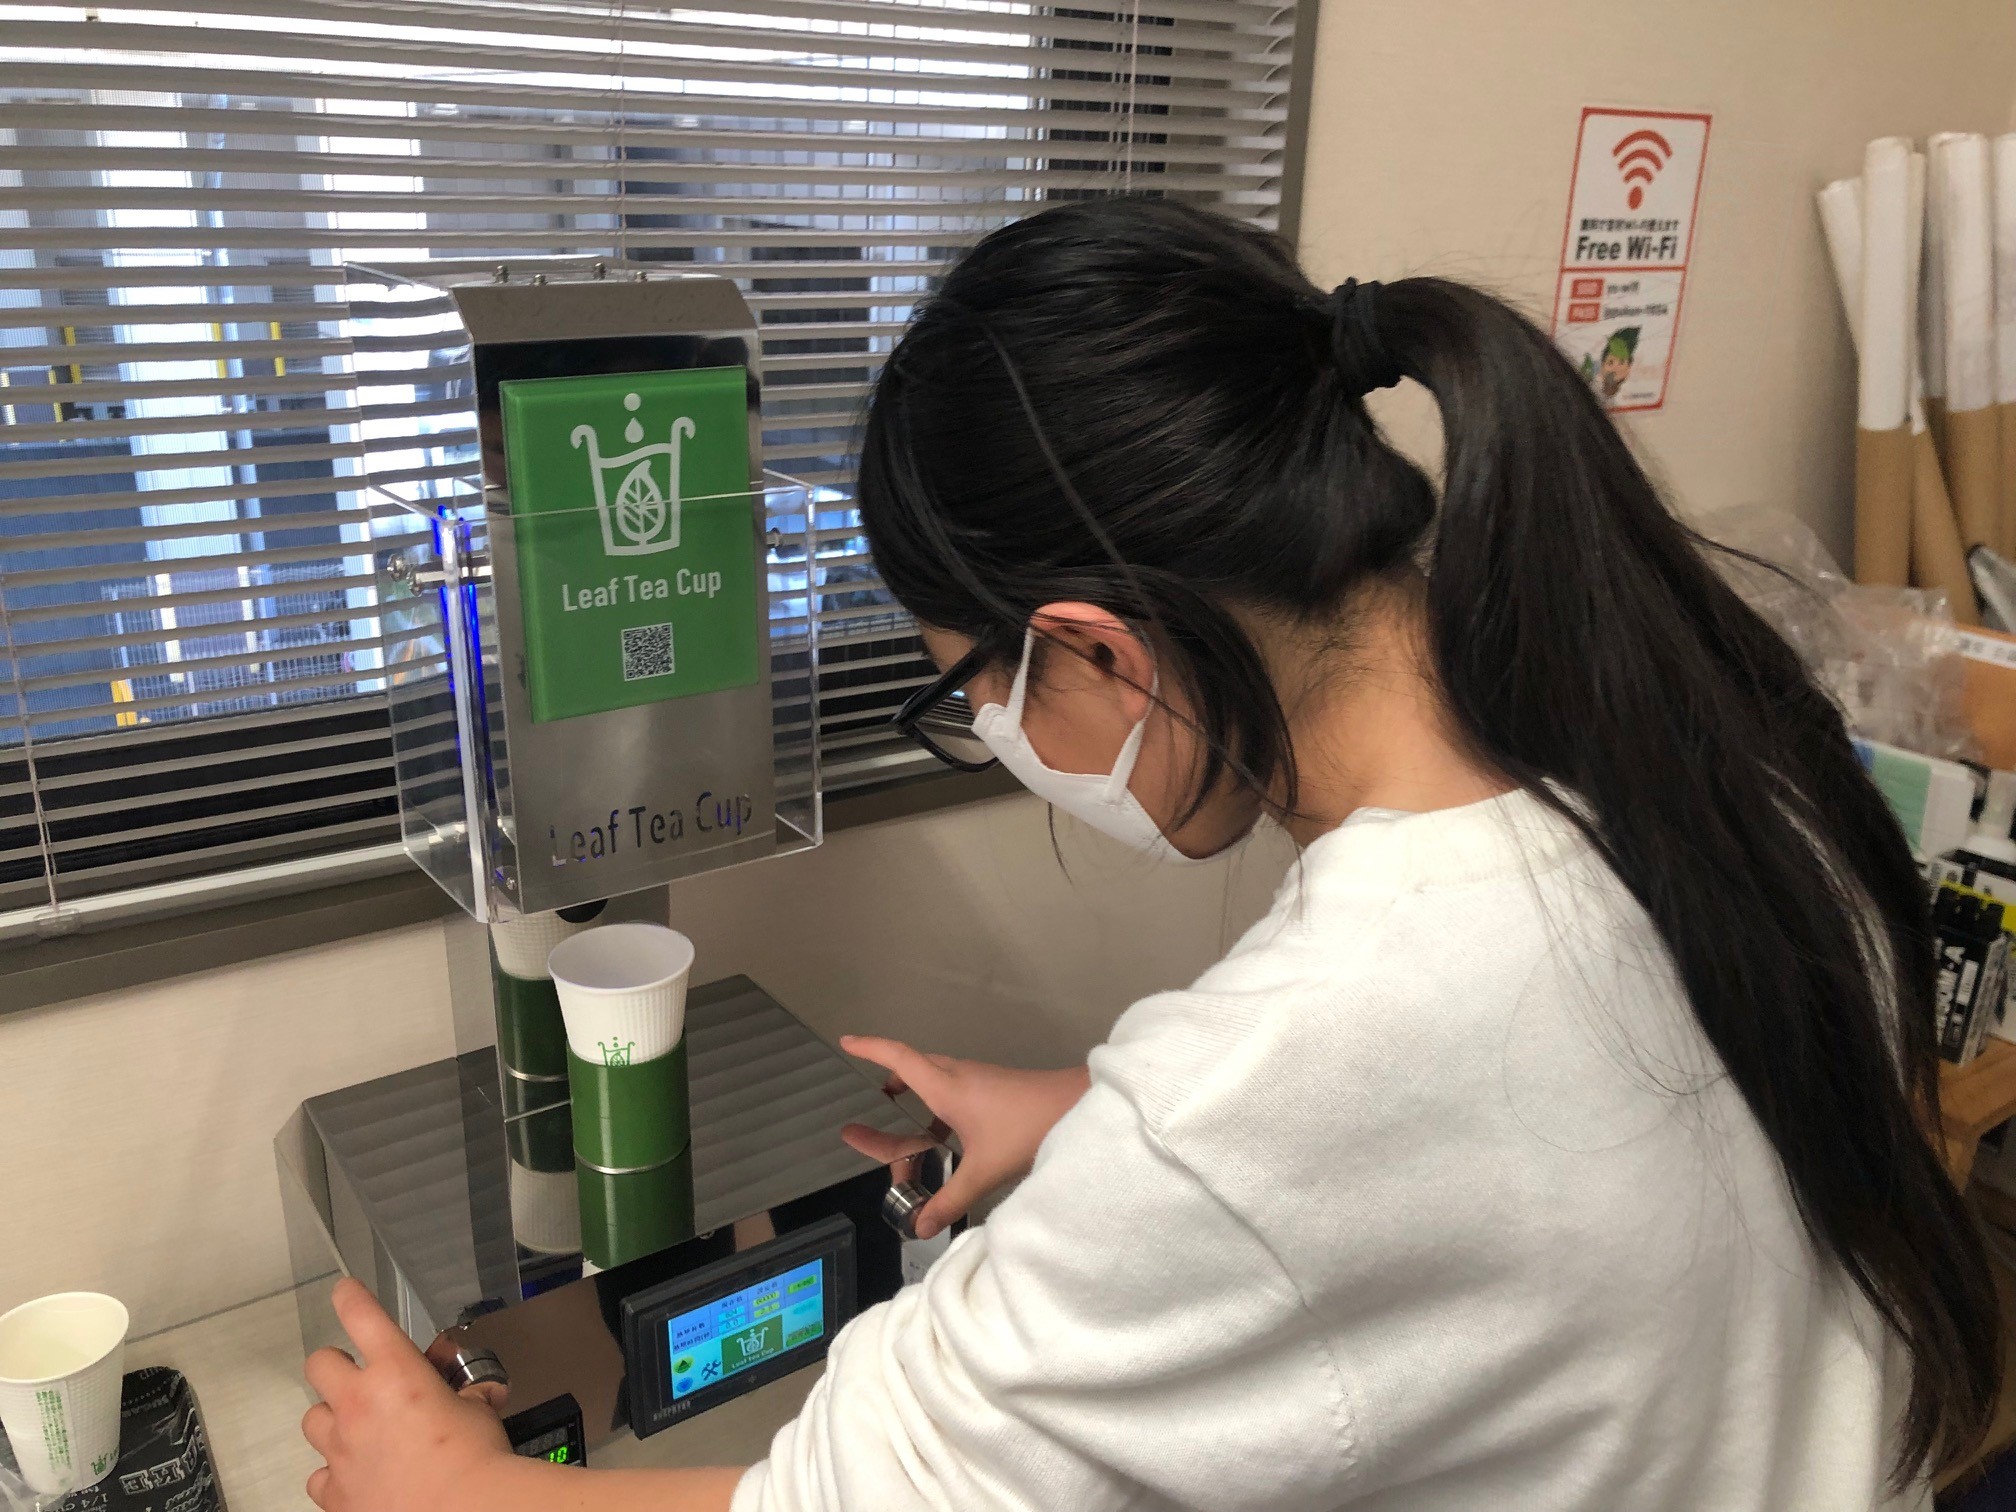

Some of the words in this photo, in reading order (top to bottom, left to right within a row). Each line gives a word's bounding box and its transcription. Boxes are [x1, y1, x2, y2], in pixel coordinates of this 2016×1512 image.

[1575, 235, 1621, 260] Free
[1627, 235, 1678, 260] Wi-Fi
[562, 577, 619, 611] Leaf
[624, 575, 669, 602] Tea
[677, 568, 721, 598] Cup
[550, 809, 619, 867] Leaf
[628, 806, 684, 848] Tea
[696, 791, 751, 835] Cup
